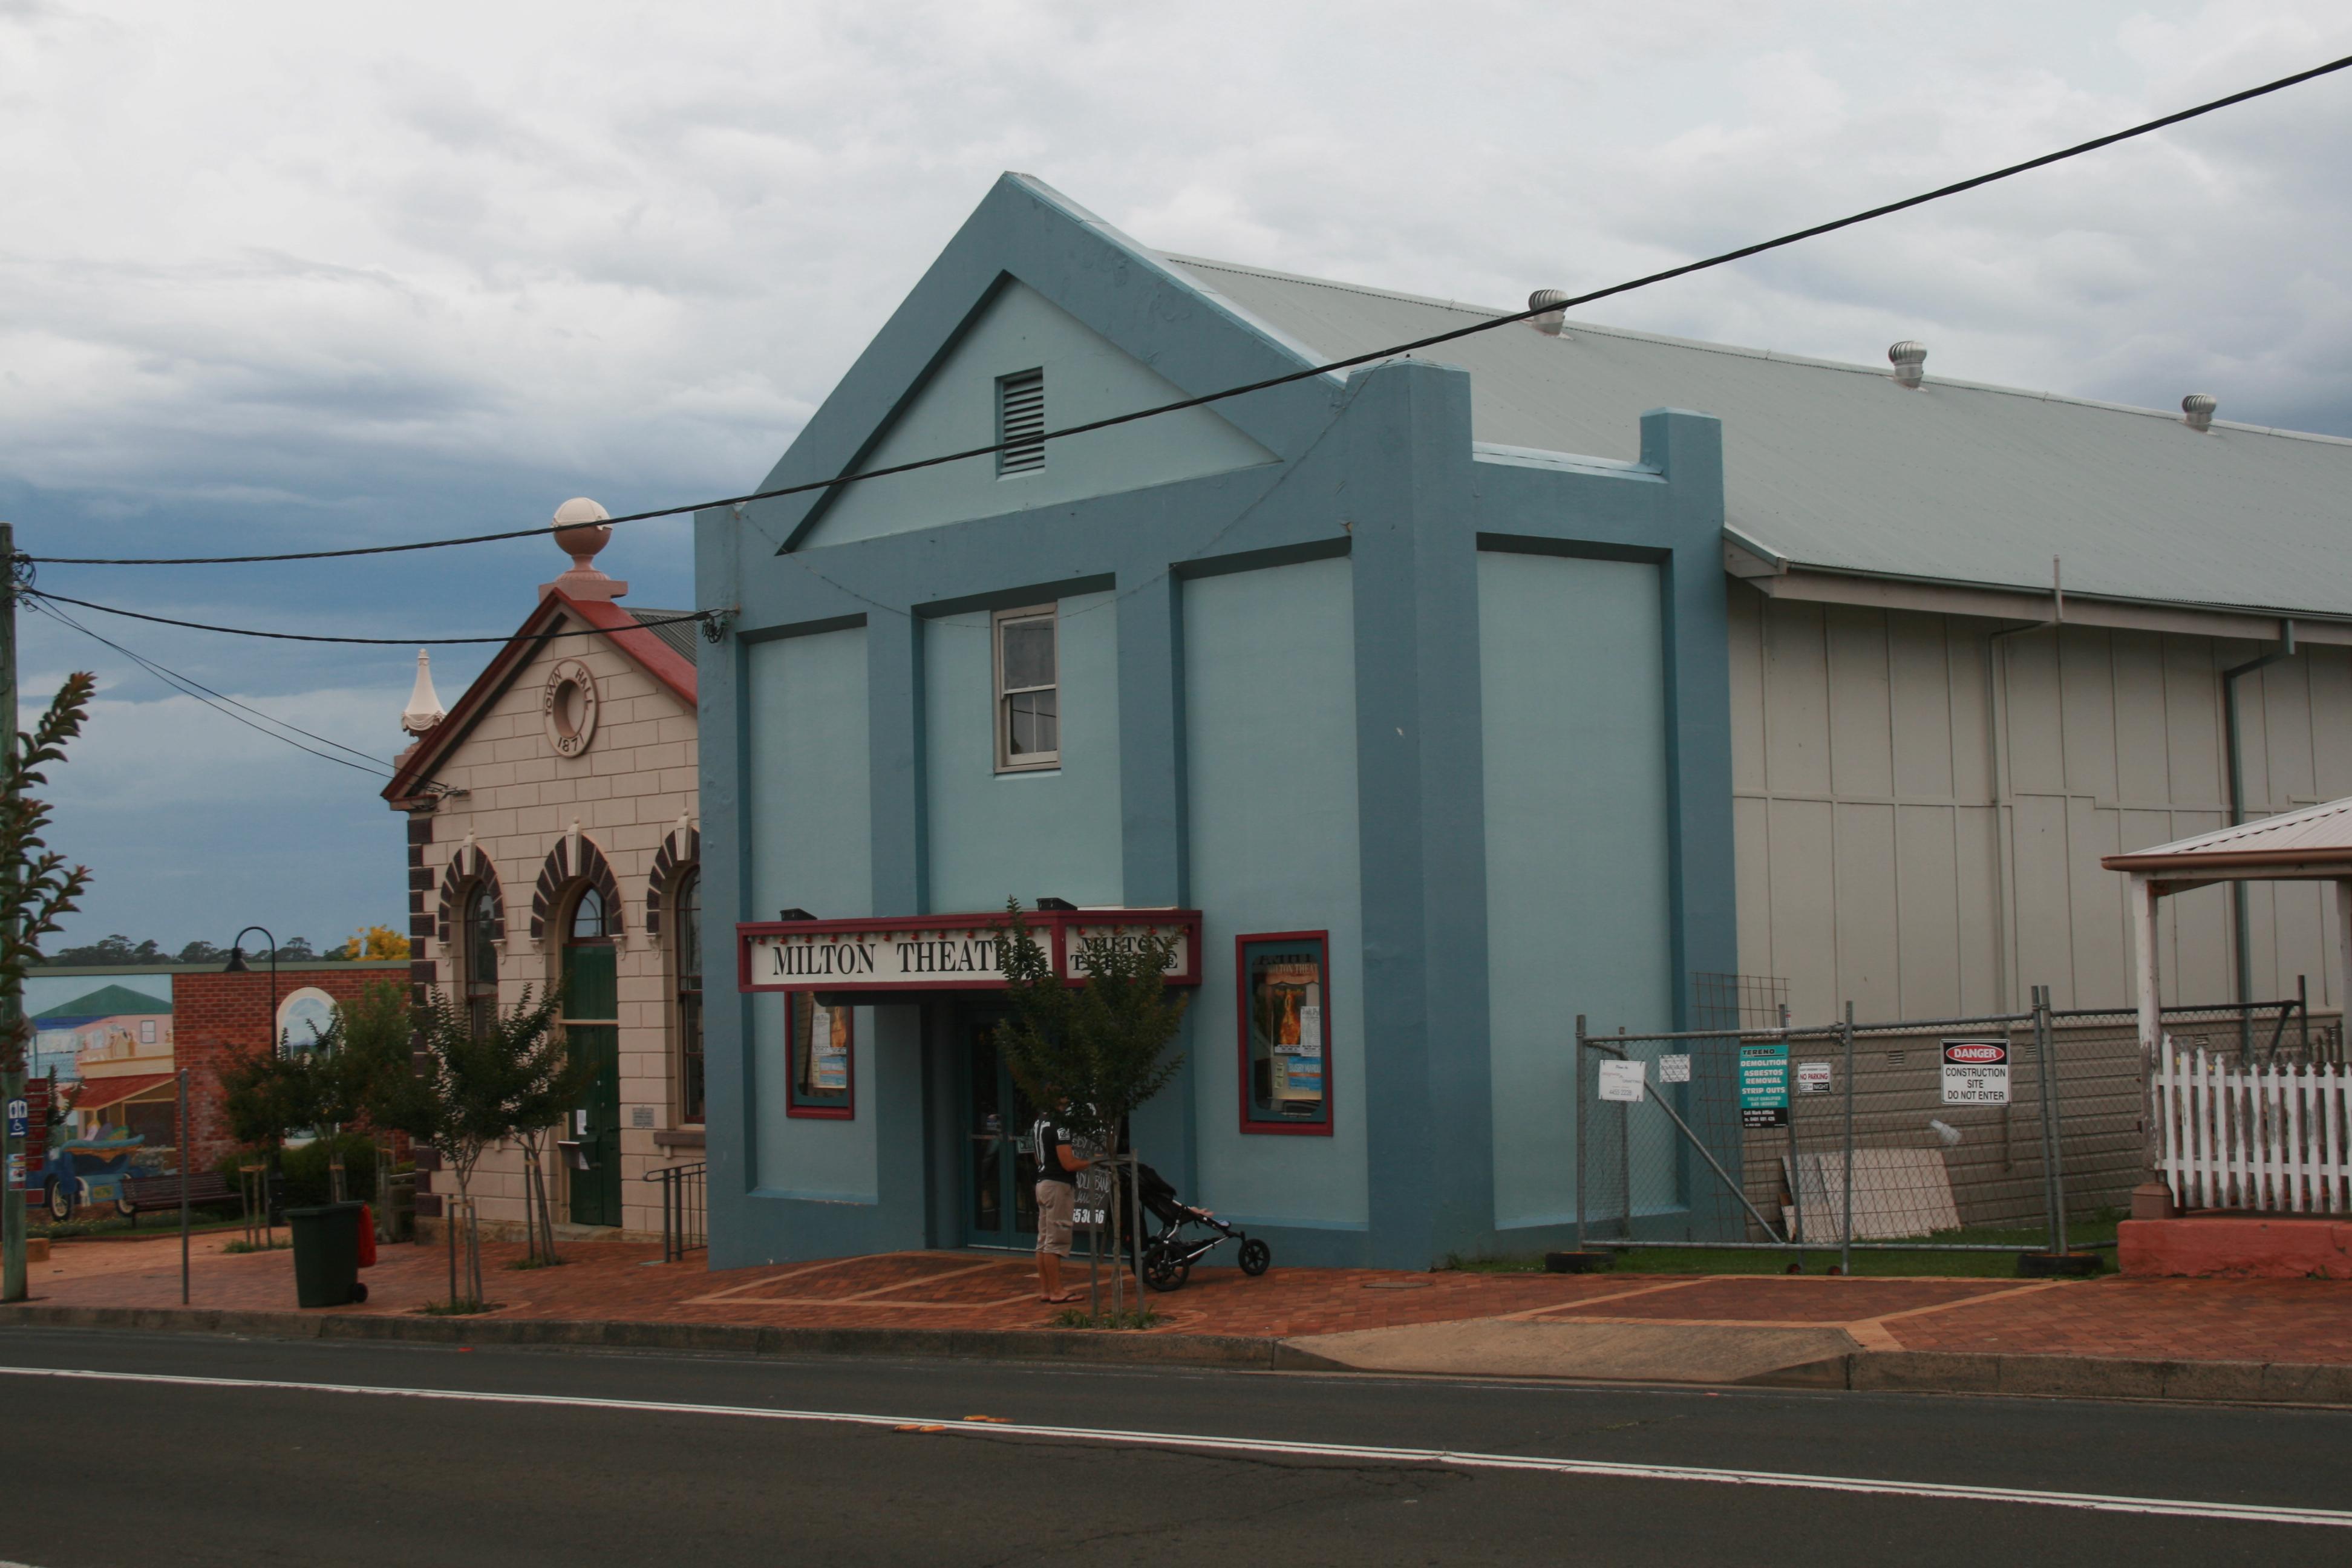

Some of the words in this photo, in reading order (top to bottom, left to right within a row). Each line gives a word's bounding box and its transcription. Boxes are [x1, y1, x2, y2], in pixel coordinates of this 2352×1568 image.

[546, 667, 562, 717] TOWN
[575, 668, 593, 711] HALL
[558, 733, 584, 752] 1871
[773, 943, 876, 975] MILTON
[897, 940, 1036, 973] THEATR
[1953, 1048, 1996, 1058] DANGER
[1945, 1068, 2005, 1077] CONSTRUCTION
[1967, 1079, 1984, 1088] SITE
[1948, 1091, 1959, 1099] DO
[1961, 1091, 1976, 1099] NOT
[1978, 1091, 2004, 1100] ENTER
